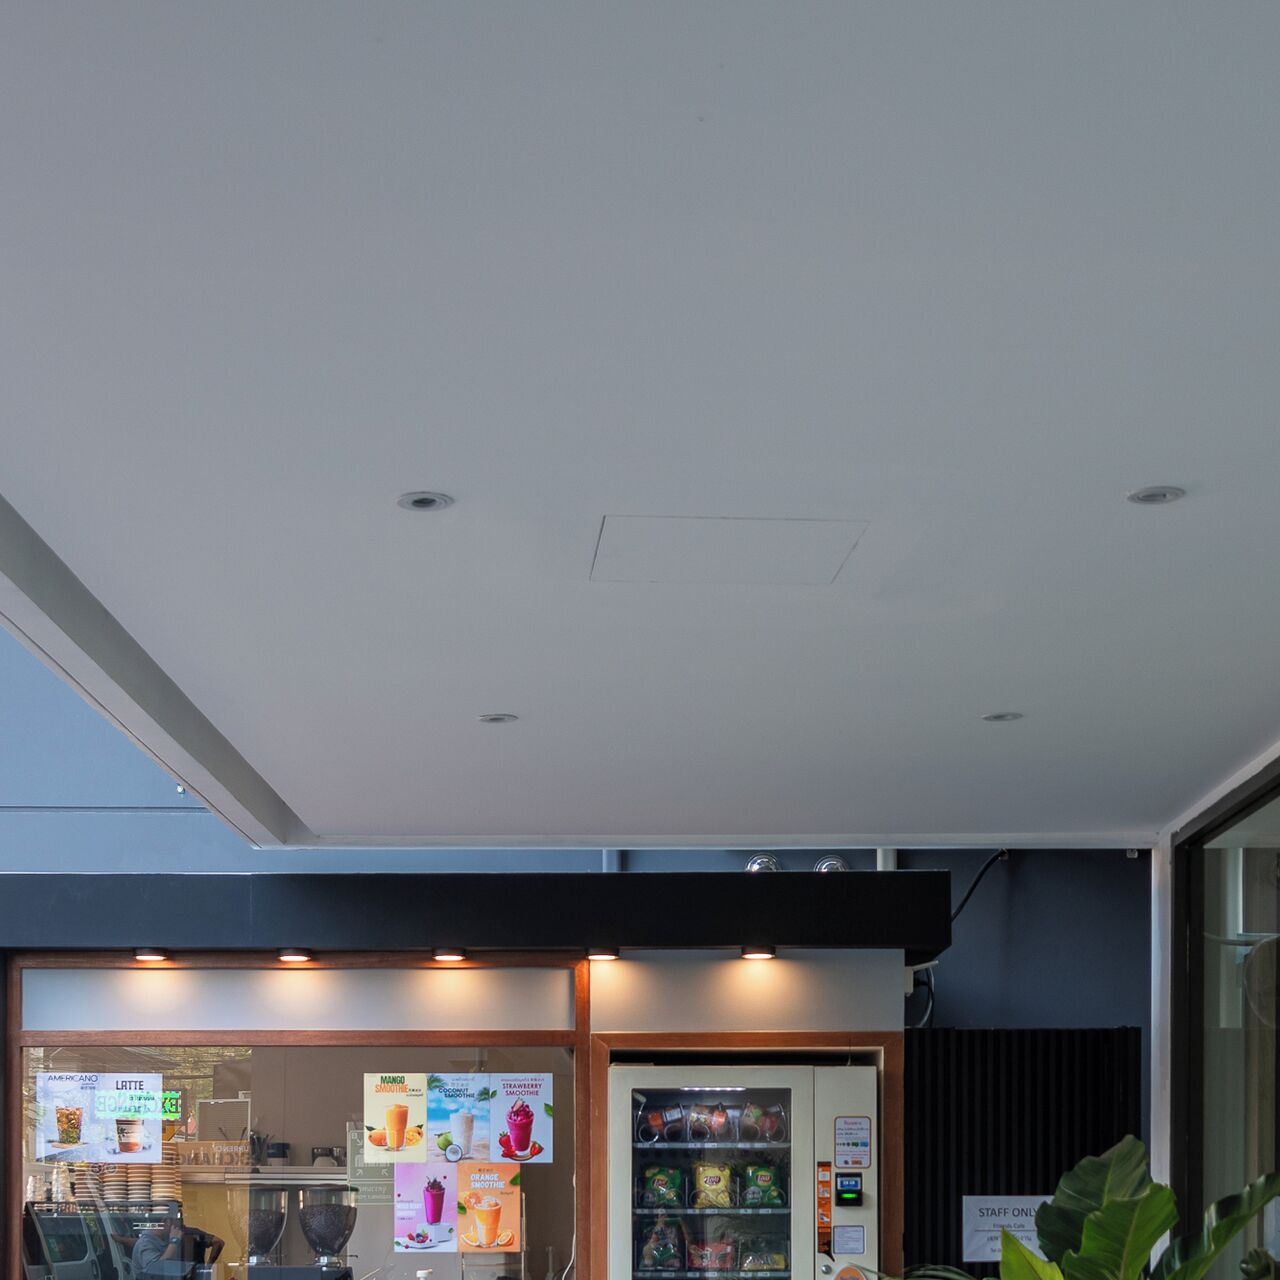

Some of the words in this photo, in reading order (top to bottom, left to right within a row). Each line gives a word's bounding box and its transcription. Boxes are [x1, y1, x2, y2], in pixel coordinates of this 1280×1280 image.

[48, 1074, 98, 1082] AMERICANO
[380, 1075, 405, 1084] MANGO
[116, 1080, 144, 1090] LATTE
[375, 1084, 409, 1093] SMOOTHIE
[978, 1207, 1009, 1217] STAFF
